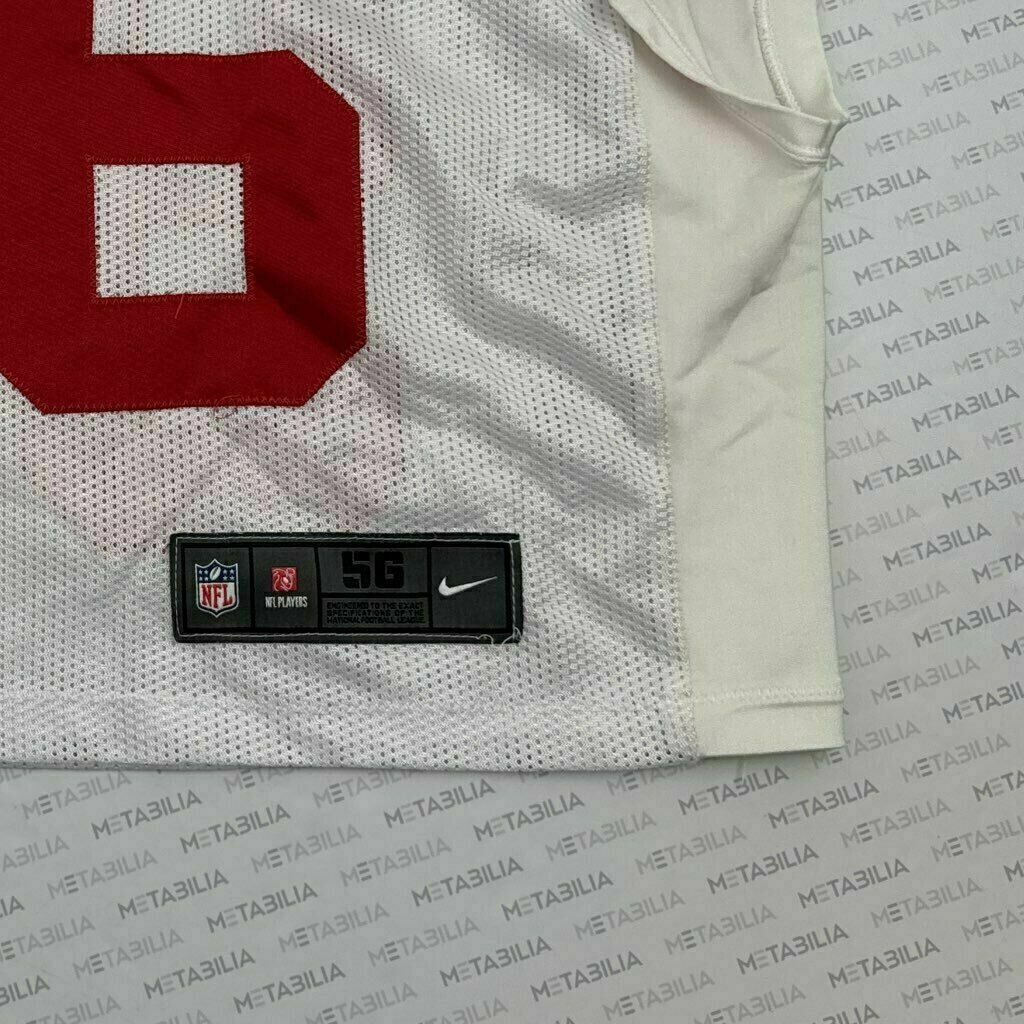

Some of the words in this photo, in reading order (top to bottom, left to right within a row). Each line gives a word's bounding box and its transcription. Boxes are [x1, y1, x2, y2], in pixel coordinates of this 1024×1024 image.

[200, 583, 235, 607] NFL
[265, 596, 277, 608] NFL
[278, 596, 308, 608] PLAYERS
